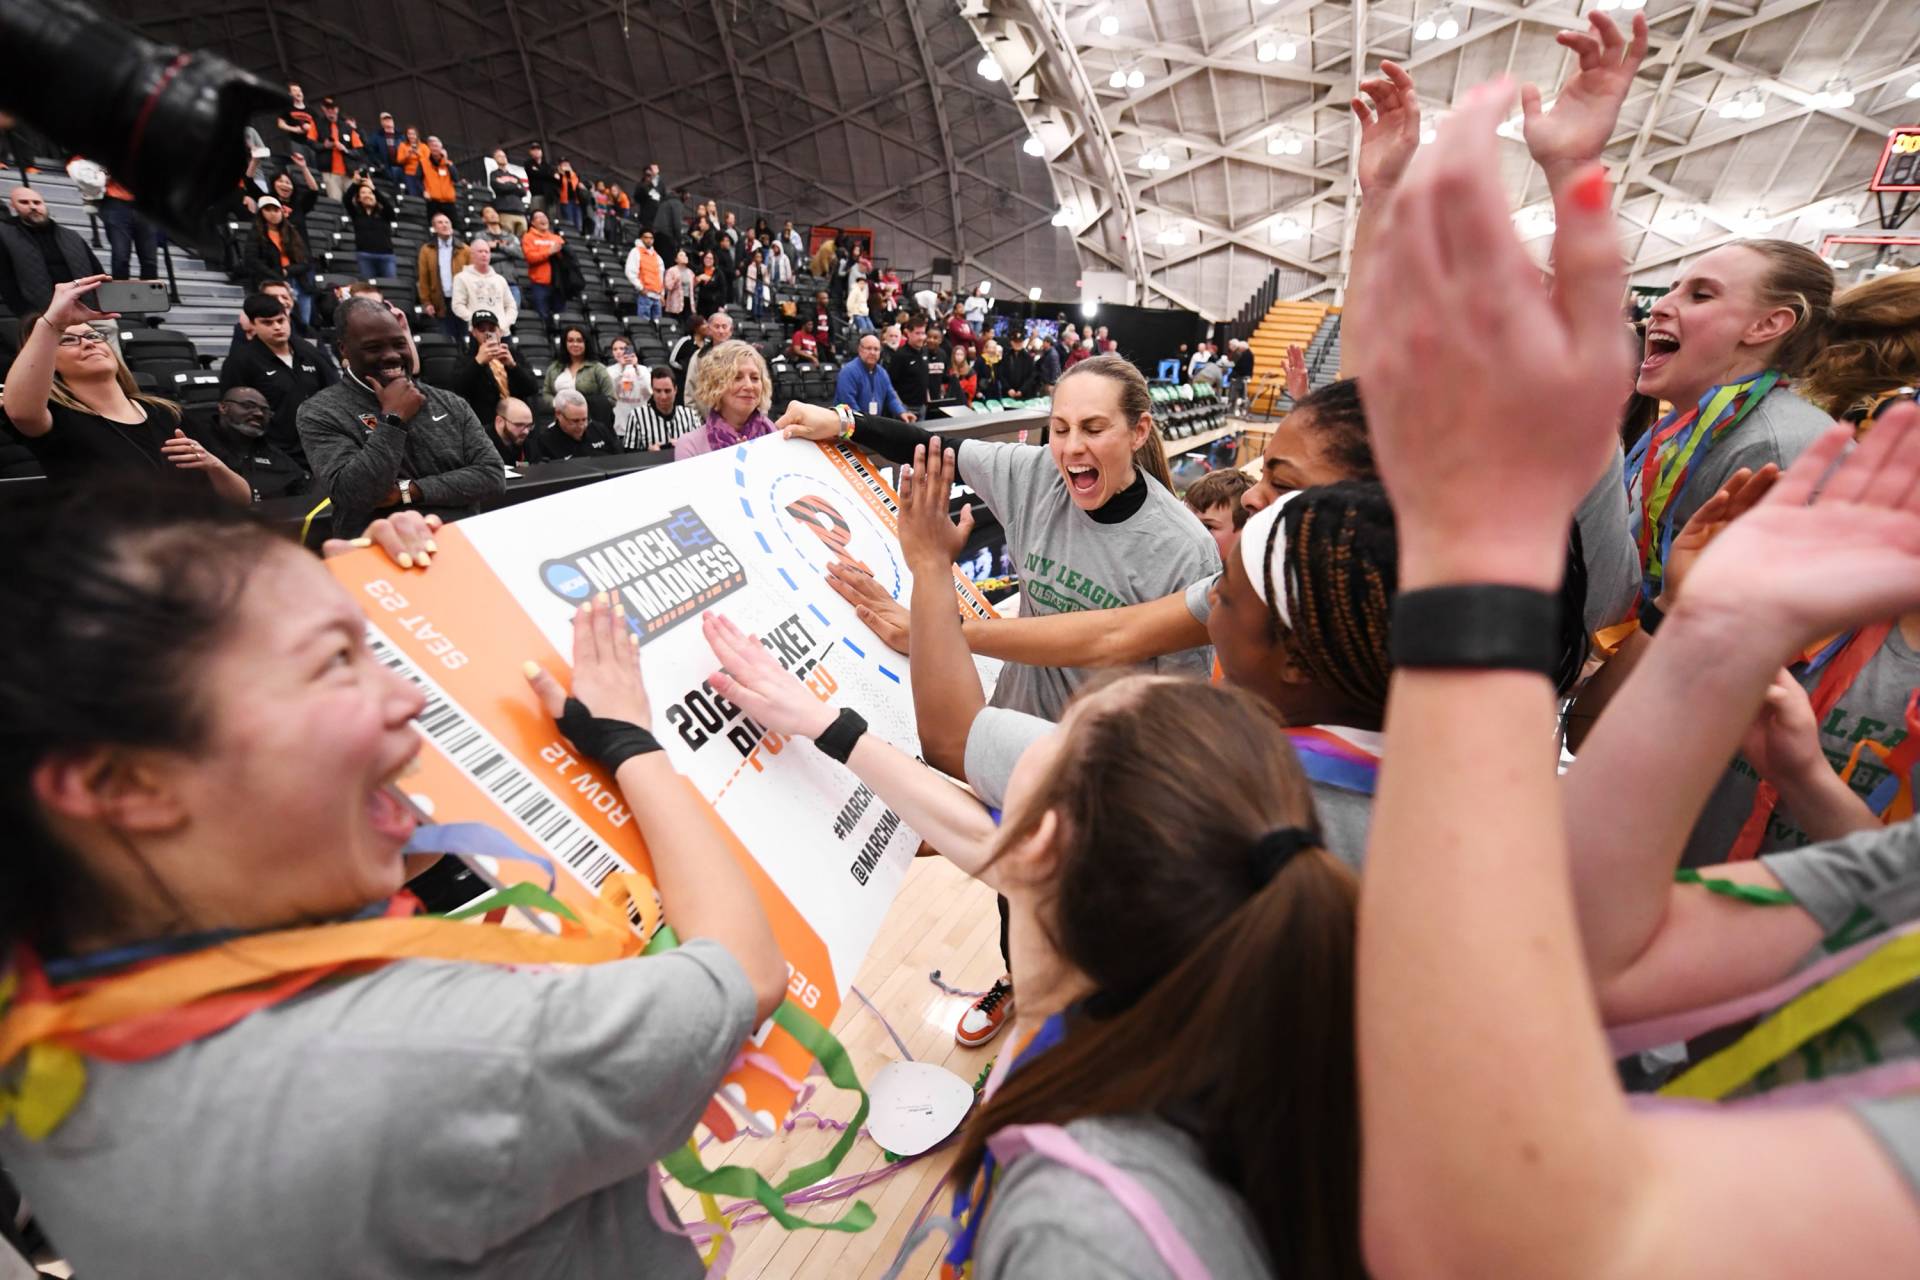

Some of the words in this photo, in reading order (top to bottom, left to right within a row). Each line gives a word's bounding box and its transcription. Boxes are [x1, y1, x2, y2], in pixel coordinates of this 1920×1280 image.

[575, 526, 682, 593] MARCH
[621, 542, 741, 622] MADNESS
[1056, 565, 1127, 610] LEAGU
[363, 578, 410, 612] 23
[396, 615, 470, 671] SEAT
[665, 667, 744, 753] 202
[759, 613, 817, 671] CKET
[540, 741, 578, 775] 12
[569, 773, 633, 829] ROW
[833, 782, 876, 842] #MARCH
[850, 808, 901, 887] @MARCHM
